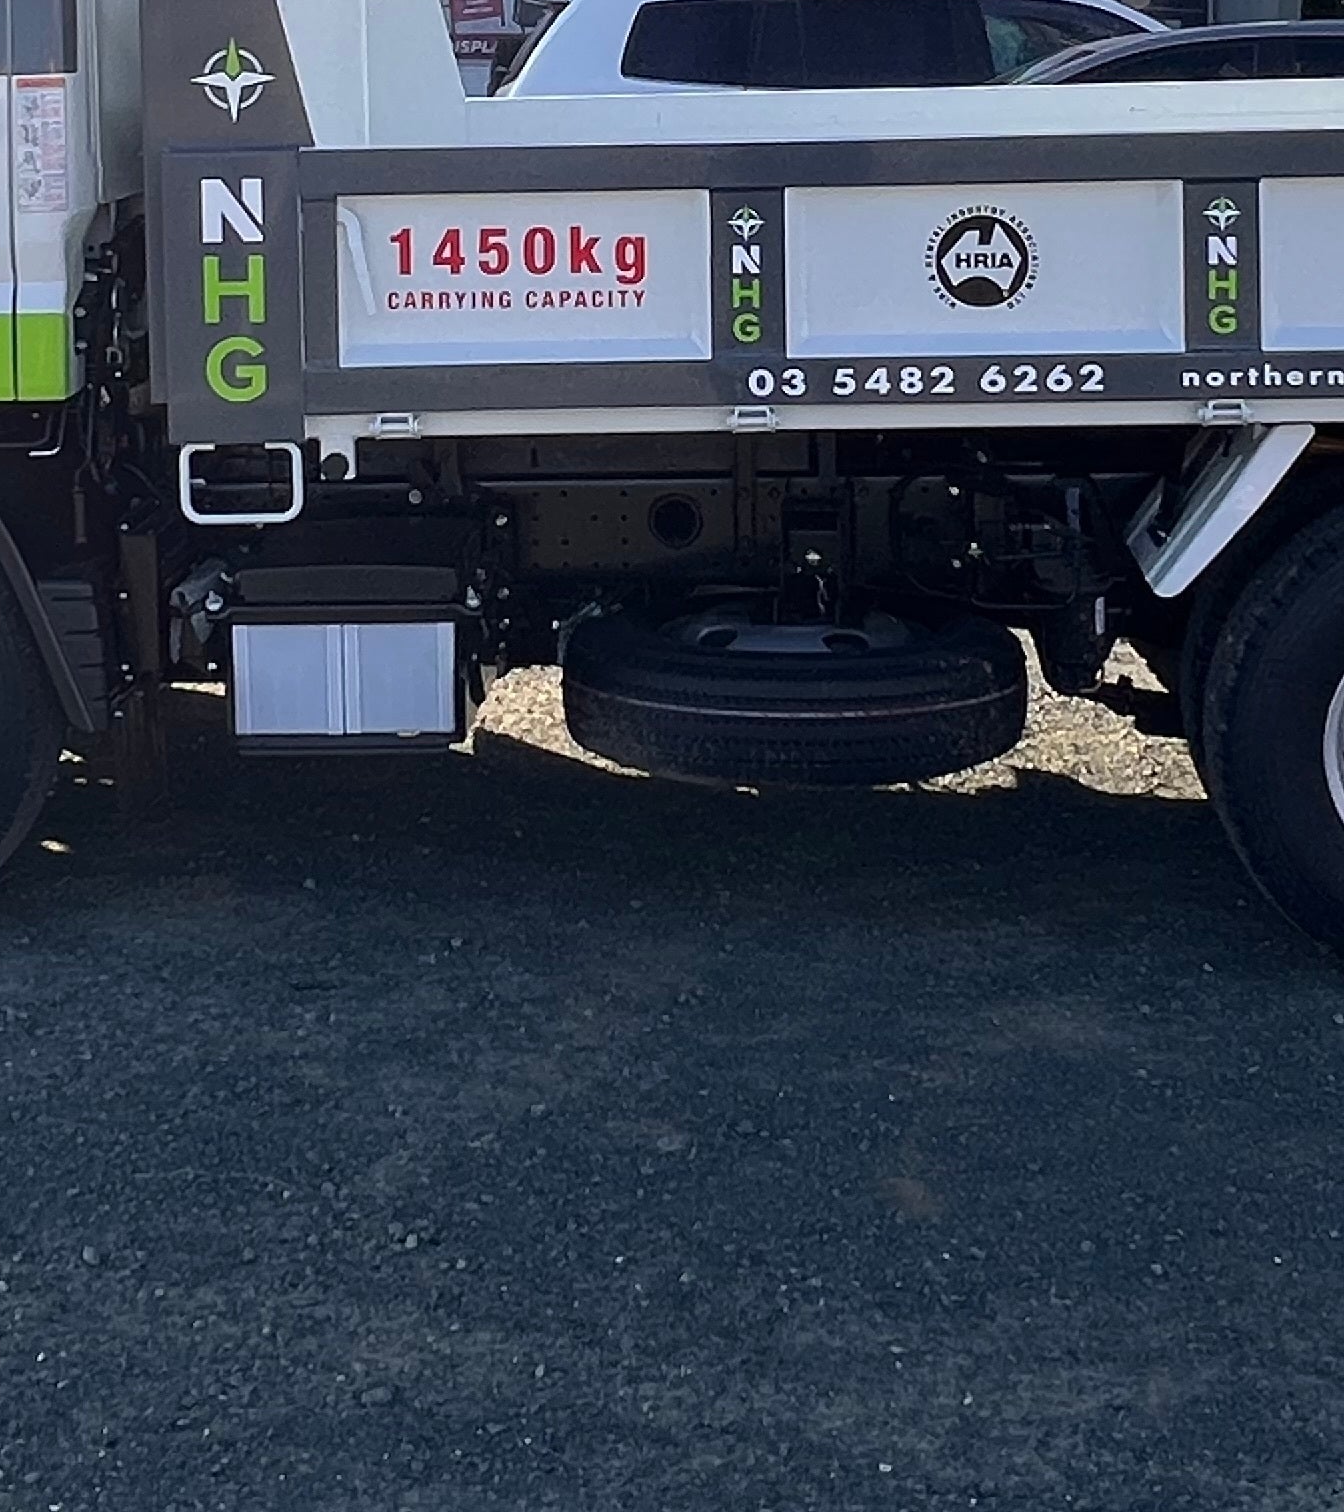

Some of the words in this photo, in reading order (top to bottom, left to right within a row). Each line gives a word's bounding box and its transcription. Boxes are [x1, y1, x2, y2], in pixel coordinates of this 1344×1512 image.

[389, 226, 647, 285] 1450kg
[954, 252, 1014, 269] HRIA
[387, 291, 513, 311] CARRYING
[525, 290, 647, 309] CAPACITY
[747, 368, 807, 397] 03
[832, 366, 956, 396] 5482
[979, 363, 1106, 394] 6262
